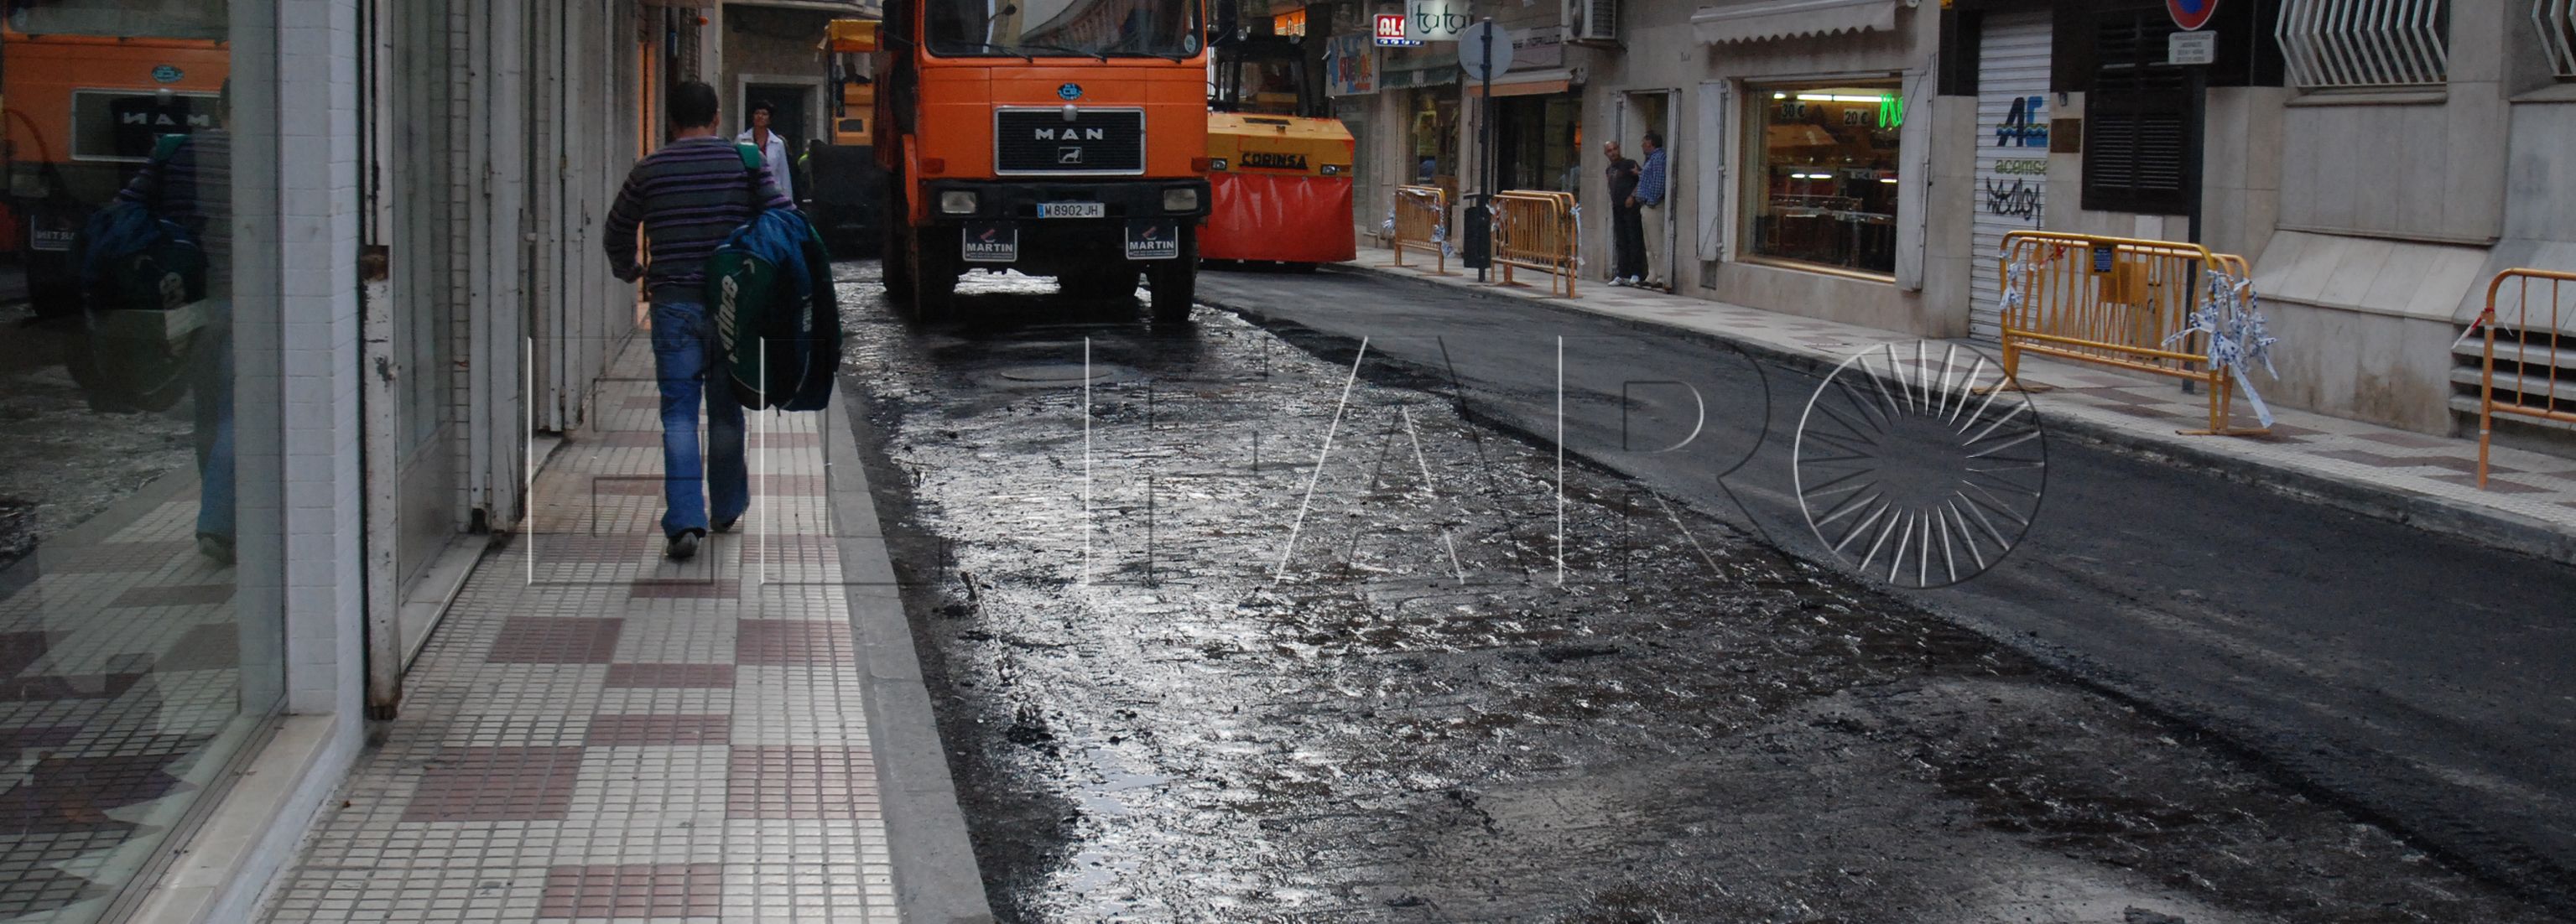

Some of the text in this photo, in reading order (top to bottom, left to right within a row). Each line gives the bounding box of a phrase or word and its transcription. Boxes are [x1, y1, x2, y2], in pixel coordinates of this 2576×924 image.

[1782, 104, 1795, 118] 30
[1845, 111, 1858, 125] 20
[1035, 128, 1104, 141] MAN
[1054, 205, 1083, 216] 8902
[1085, 205, 1099, 216] JH
[966, 242, 1013, 252] MARTIN
[1129, 241, 1174, 250] MARTIN
